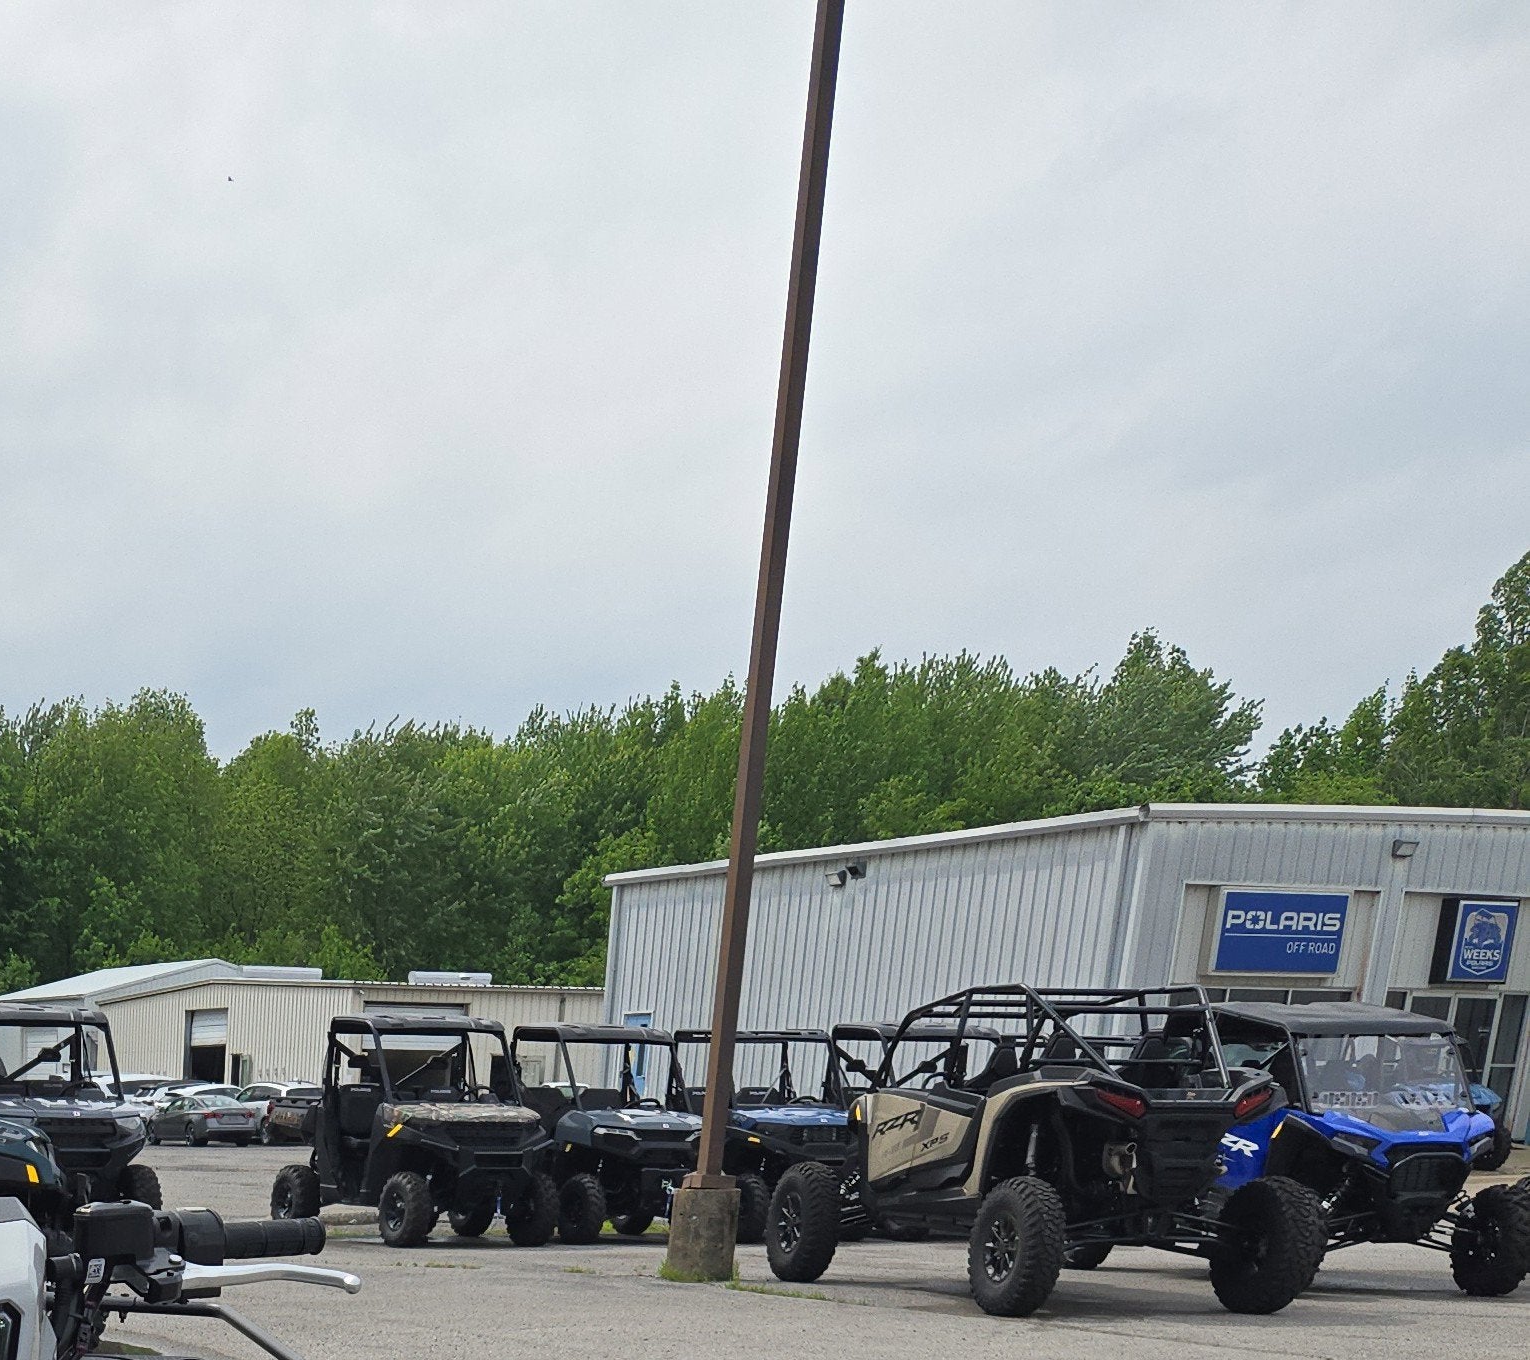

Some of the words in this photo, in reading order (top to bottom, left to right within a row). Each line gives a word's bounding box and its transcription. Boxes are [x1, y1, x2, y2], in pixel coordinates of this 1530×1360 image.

[1226, 910, 1341, 931] POLARIS
[1286, 942, 1308, 954] OFF
[1308, 942, 1336, 954] ROAD
[1463, 949, 1501, 961] WEEKS
[871, 1108, 923, 1141] RZR
[920, 1132, 950, 1152] XPS
[1220, 1132, 1260, 1158] ZR
